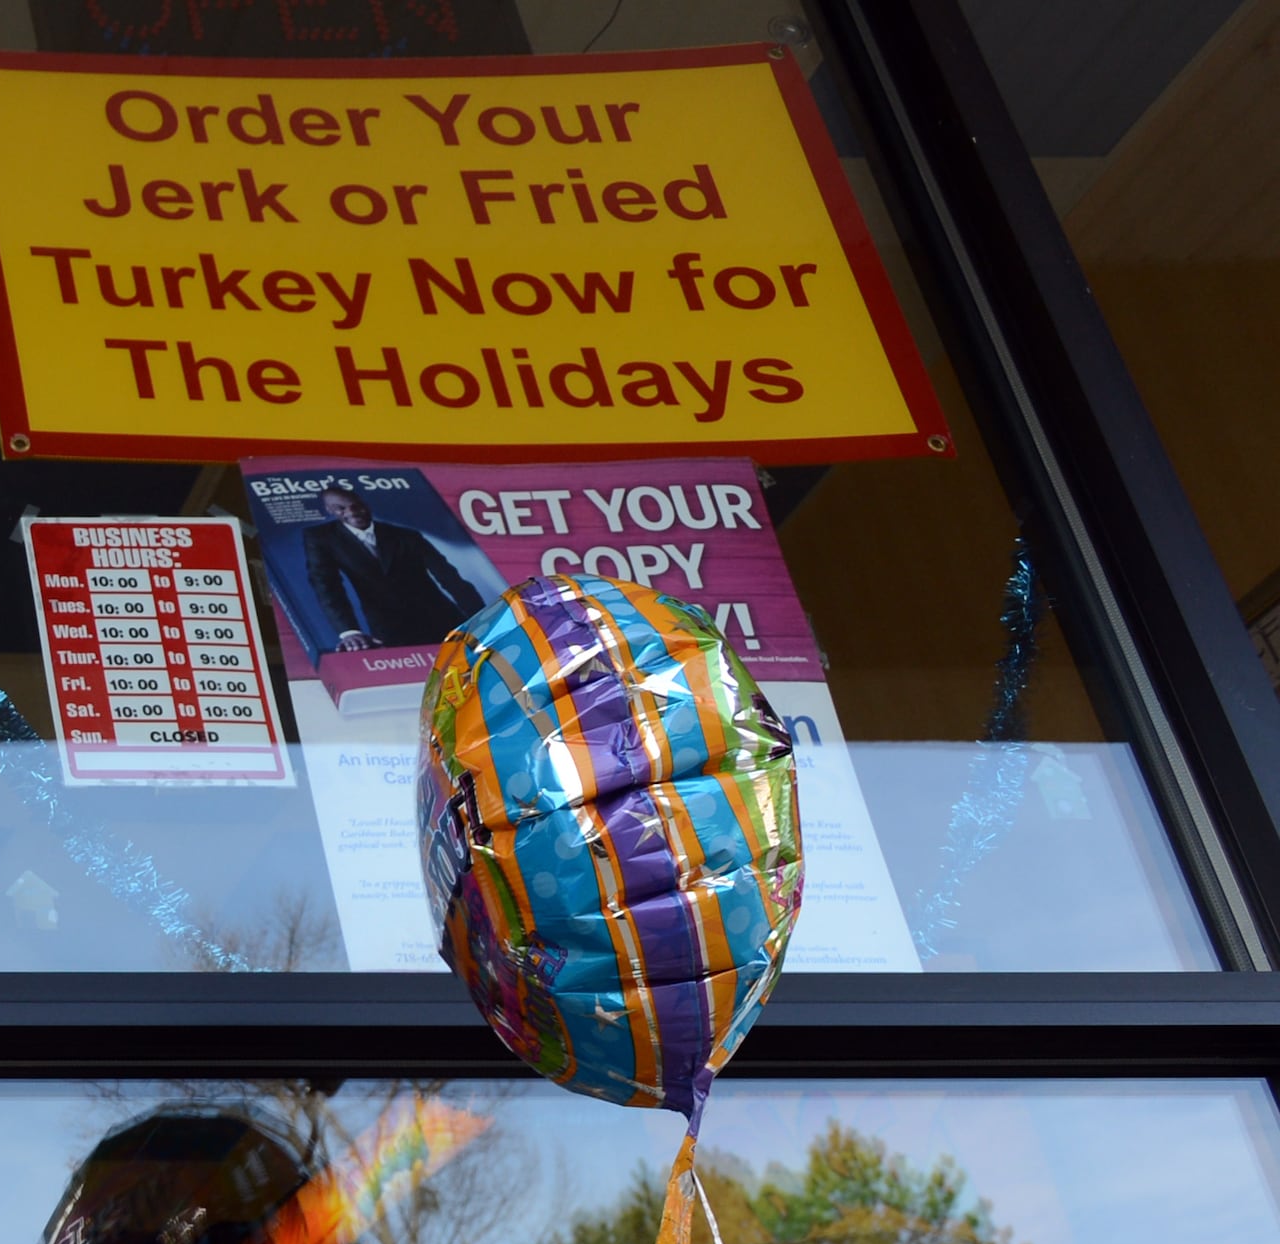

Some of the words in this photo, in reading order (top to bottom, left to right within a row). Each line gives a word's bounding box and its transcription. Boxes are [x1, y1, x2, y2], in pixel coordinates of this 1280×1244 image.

[104, 90, 380, 147] Order
[405, 92, 641, 146] Your
[83, 163, 298, 226] Jerk
[328, 176, 428, 228] or
[461, 164, 728, 227] Fried
[30, 246, 371, 331] Turkey
[408, 256, 636, 318] Now
[667, 251, 818, 312] for
[105, 337, 302, 402] The
[335, 345, 805, 423] Holidays
[250, 475, 354, 497] Baker's
[357, 475, 410, 491] Son
[459, 489, 571, 536] GET
[583, 484, 762, 533] YOUR
[72, 527, 194, 548] BUSINESS
[91, 548, 182, 569] HOURS:
[44, 573, 85, 589] Mon.
[153, 575, 171, 588] to
[49, 599, 91, 614] Tues.
[158, 600, 176, 613] to
[52, 624, 93, 639] Wed.
[163, 626, 180, 639] to
[57, 650, 100, 665] Thur.
[168, 651, 186, 665] to
[362, 653, 424, 672] Lowell
[61, 676, 91, 691] Fri.
[173, 676, 191, 691] to
[66, 702, 100, 718] Sat.
[178, 703, 197, 717] to
[70, 729, 108, 744] Sun.
[150, 731, 219, 744] CLOSED
[338, 753, 361, 767] An
